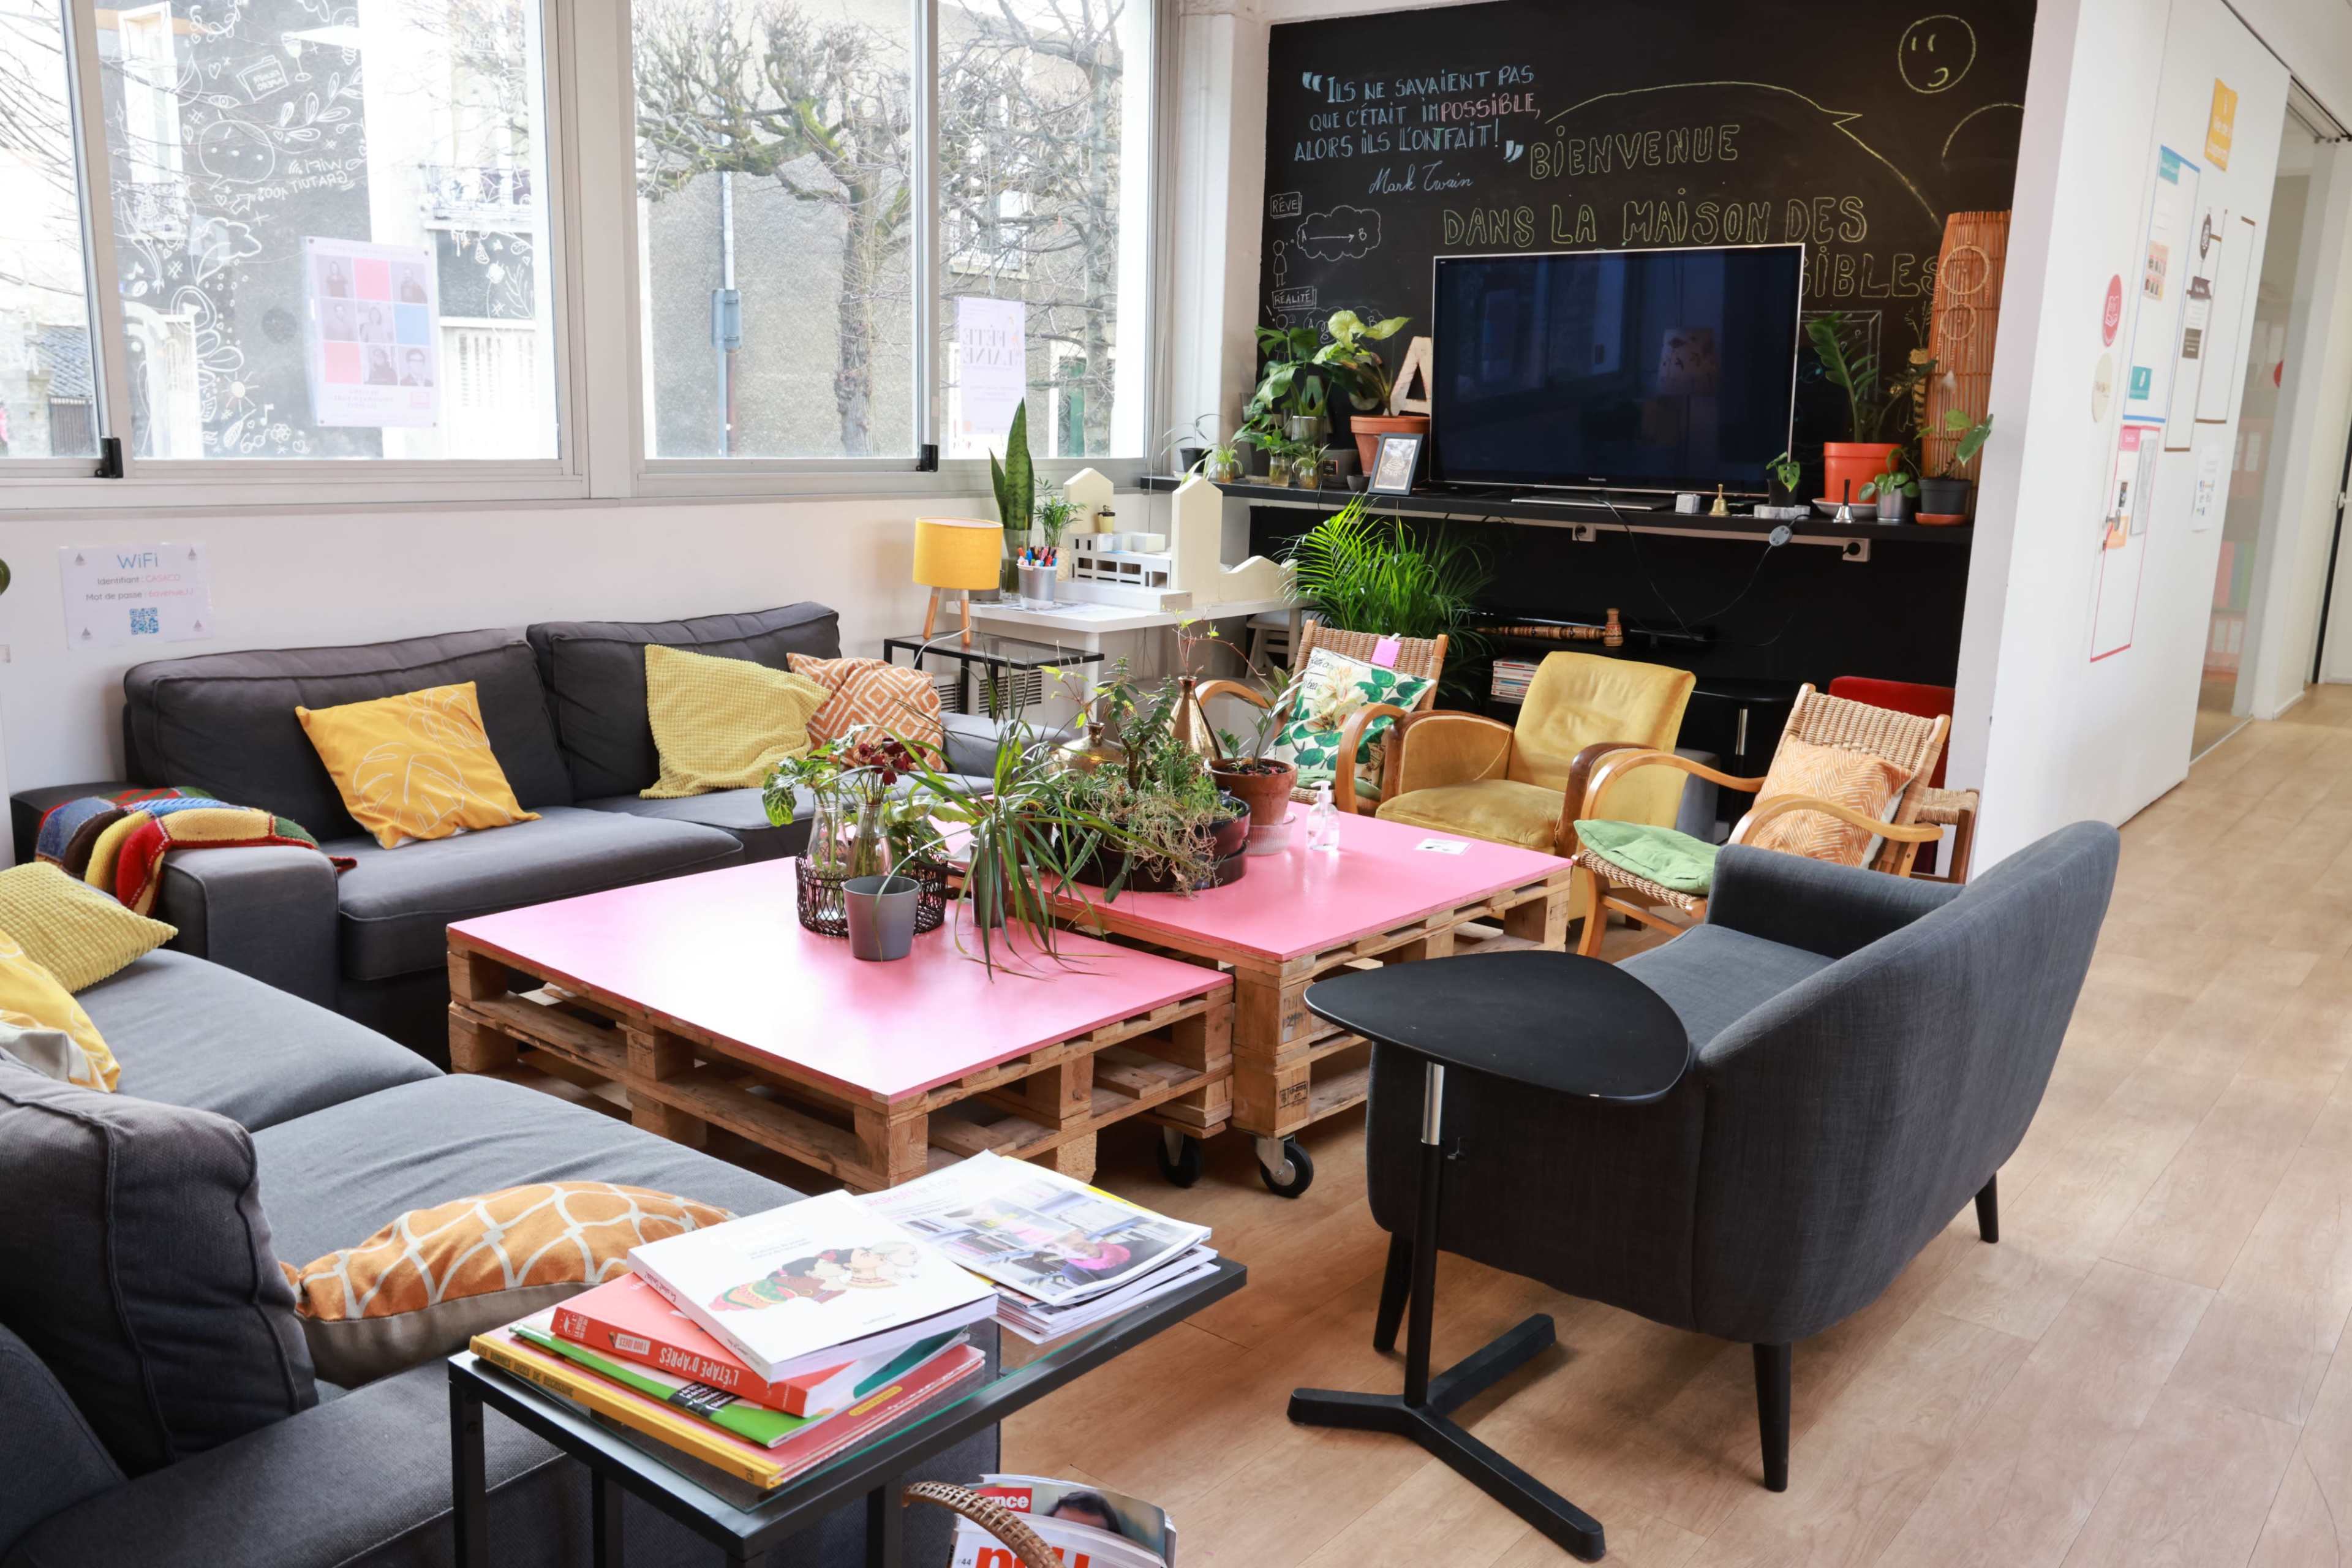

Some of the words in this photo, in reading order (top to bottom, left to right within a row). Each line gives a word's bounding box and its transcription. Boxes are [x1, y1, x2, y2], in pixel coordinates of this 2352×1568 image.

[1364, 81, 1384, 99] NE
[1395, 69, 1490, 96] SAVAIENT
[1498, 65, 1534, 85] PAS
[1310, 111, 1340, 131] QUE
[1346, 101, 1407, 127] C'ÉTAIT
[1294, 135, 1353, 162] ALORS
[1361, 130, 1390, 154] ILS
[1531, 123, 1740, 179] BIENVENUE
[1369, 164, 1415, 194] Mark
[1422, 160, 1474, 192] Twain
[1272, 197, 1299, 214] RÊVE
[1443, 206, 1534, 247] DANS
[1551, 204, 1597, 244] LA
[1623, 187, 1771, 246] MAISON
[1785, 195, 1868, 244] DES
[1301, 229, 1307, 243] A
[1359, 228, 1367, 241] B
[1274, 289, 1313, 305] RÉALITÉ
[116, 552, 159, 570] WiFi
[97, 576, 140, 586] Identifiant
[85, 593, 102, 601] Mot
[118, 590, 142, 600] passe
[659, 1347, 699, 1375] D'APRÈS
[702, 1360, 739, 1387] L'ÉTAPE
